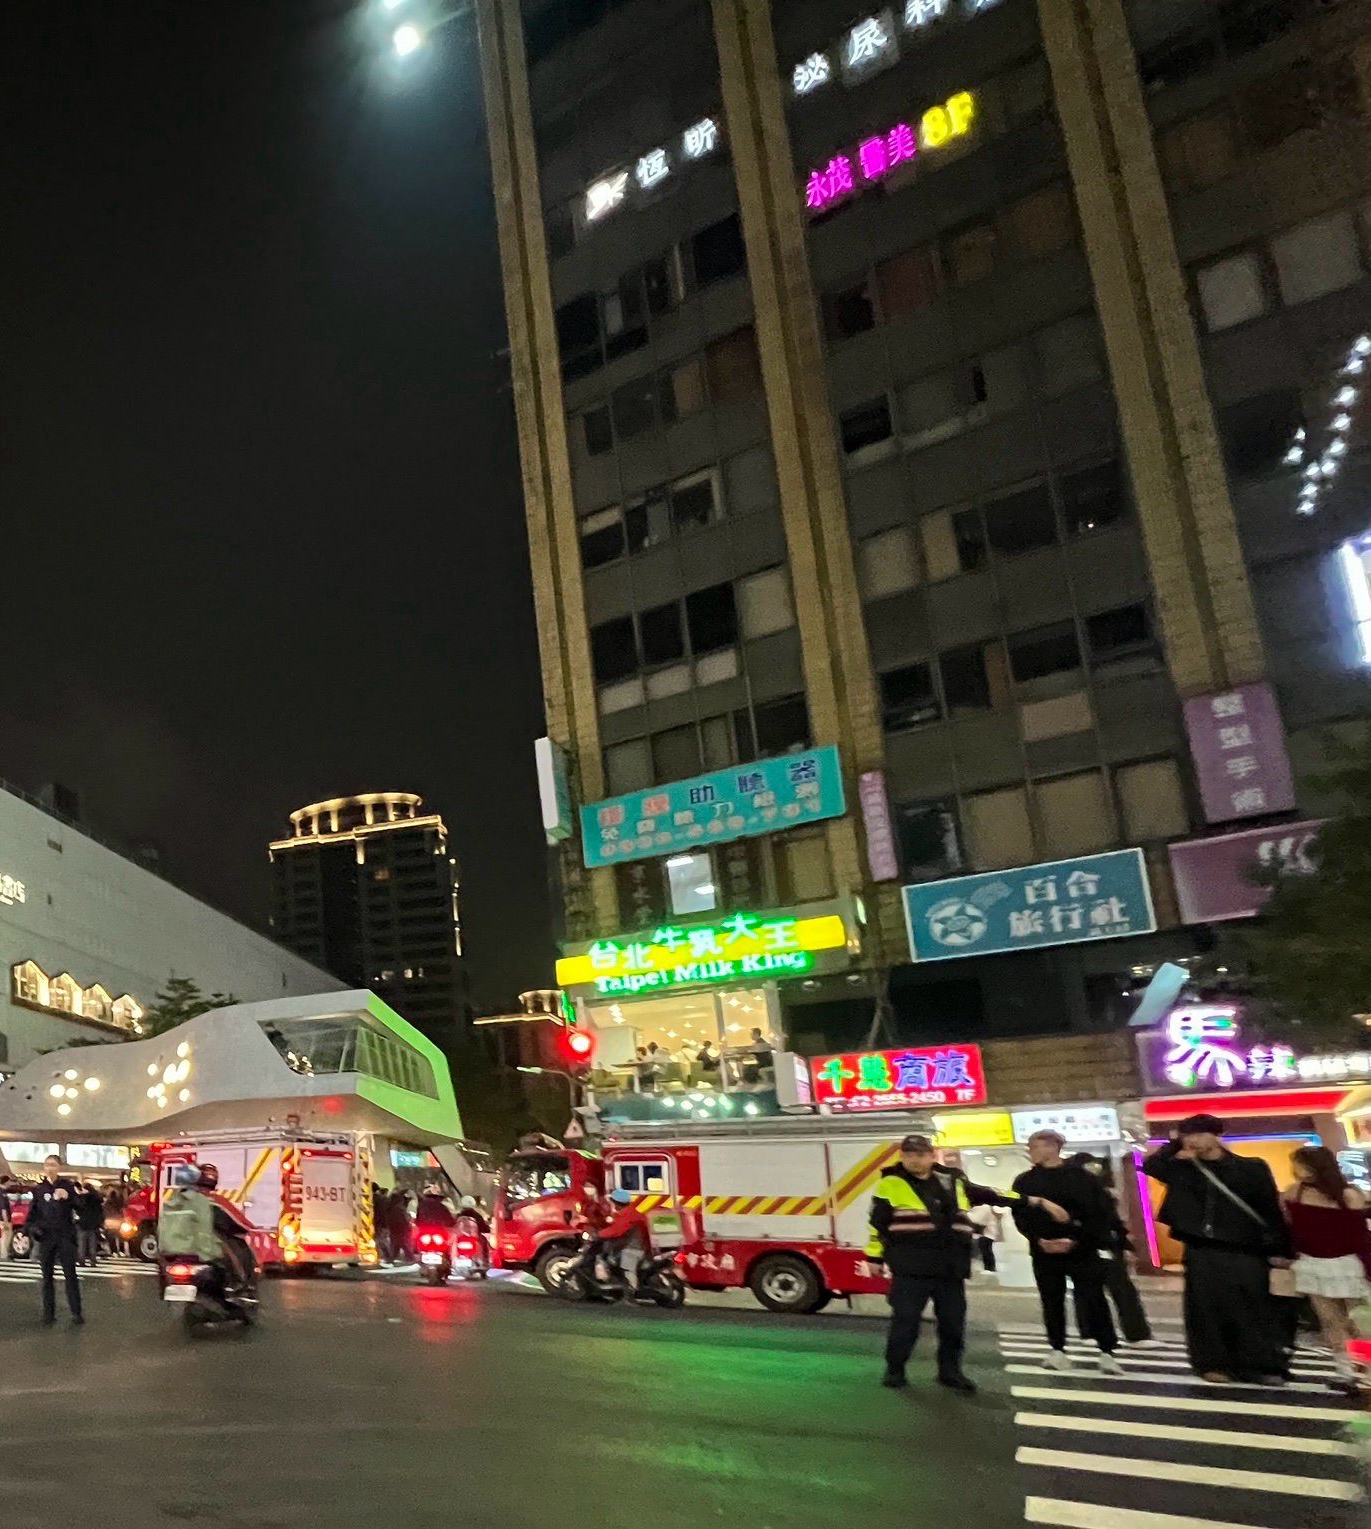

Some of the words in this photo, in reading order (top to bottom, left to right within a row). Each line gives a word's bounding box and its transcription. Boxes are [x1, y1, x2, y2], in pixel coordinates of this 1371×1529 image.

[922, 91, 974, 147] 8F
[1009, 896, 1130, 937] 旅行社
[588, 912, 800, 971] 台北牛乳大王
[594, 970, 668, 994] Taipei
[674, 959, 735, 983] Milk
[741, 950, 807, 973] King
[305, 1185, 346, 1202] 943-BT
